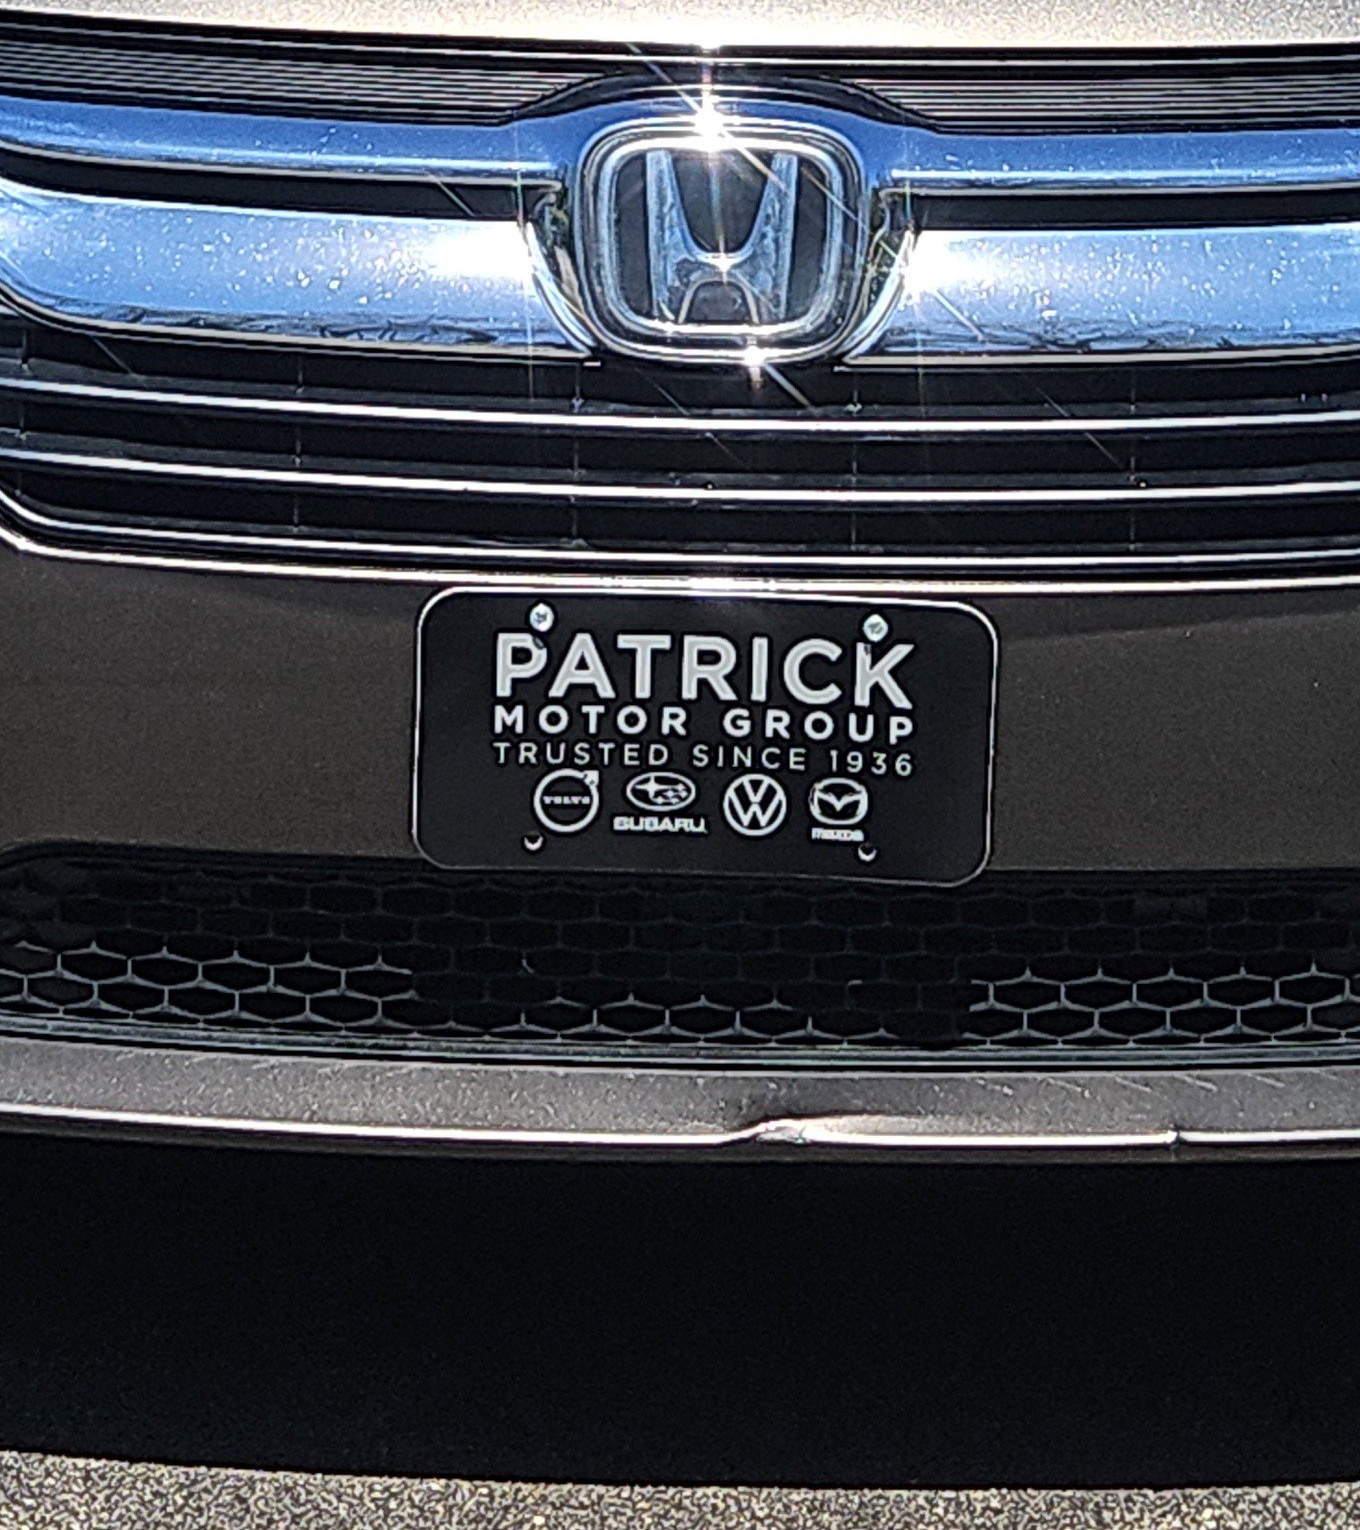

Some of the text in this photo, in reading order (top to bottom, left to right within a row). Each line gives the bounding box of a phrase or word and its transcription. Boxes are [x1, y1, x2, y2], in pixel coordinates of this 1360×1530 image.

[496, 632, 915, 710] PATRICK
[494, 704, 913, 745] MOTOR GROUP
[493, 741, 912, 777] TRUSTED SINCE 1936
[613, 816, 707, 833] SUBARU
